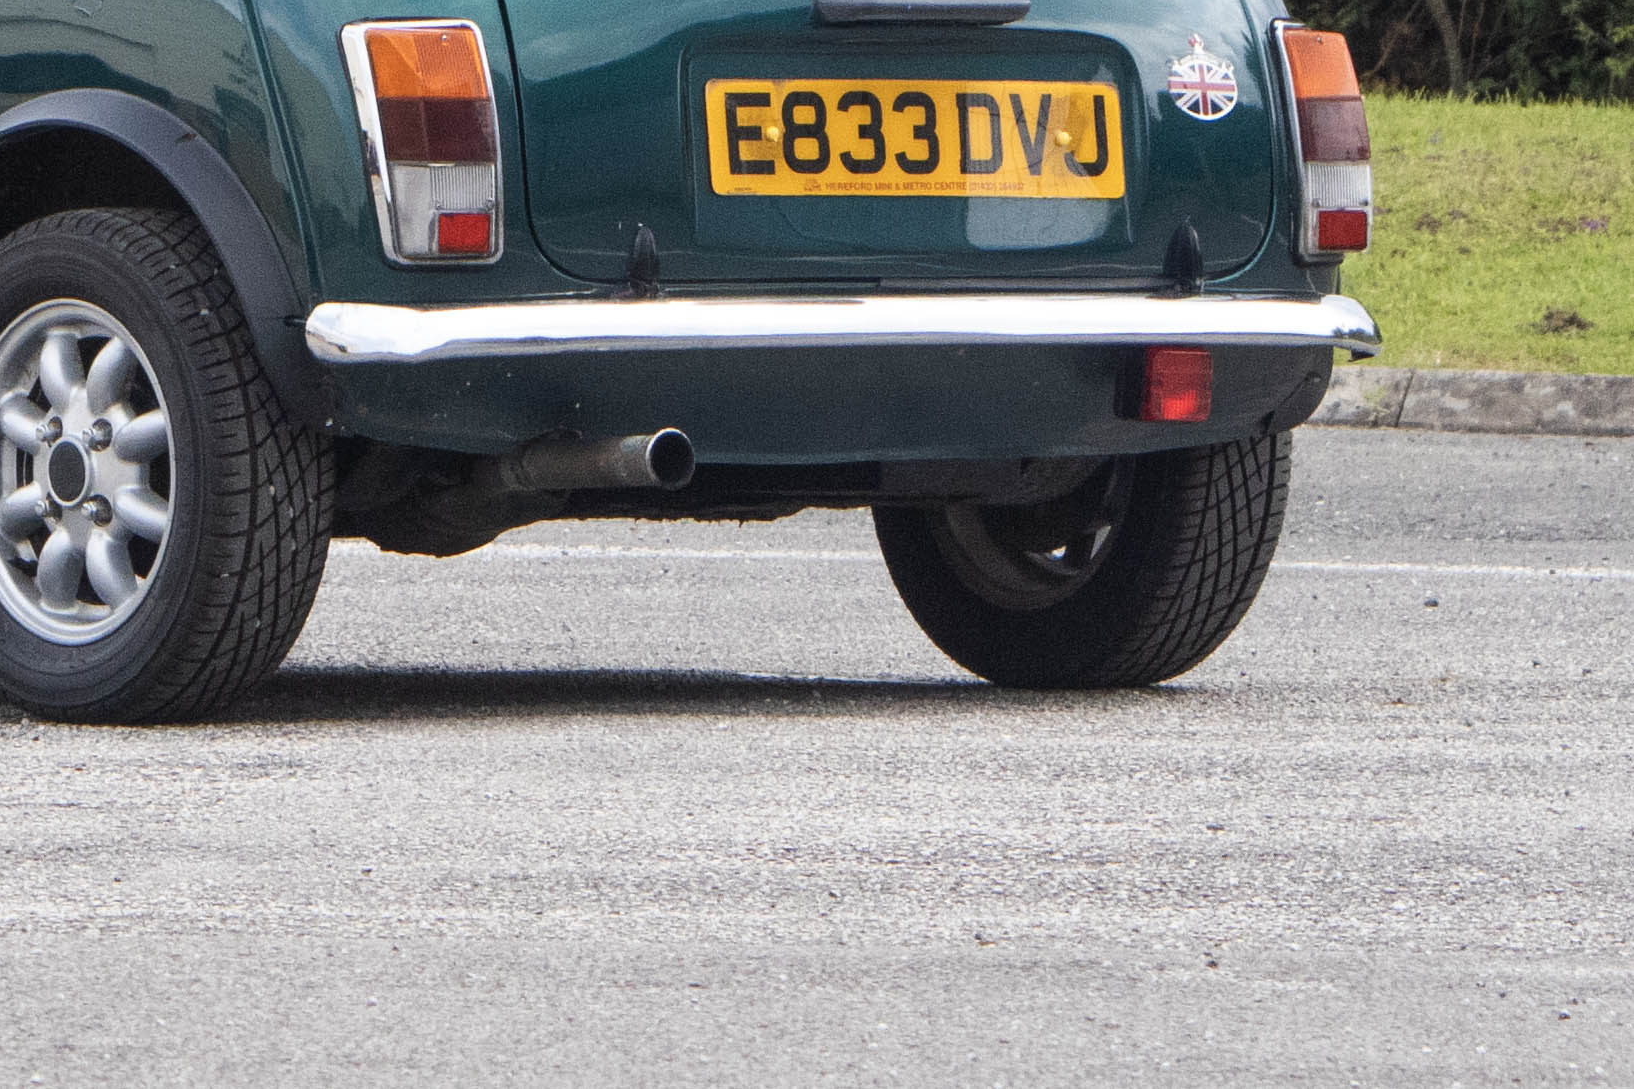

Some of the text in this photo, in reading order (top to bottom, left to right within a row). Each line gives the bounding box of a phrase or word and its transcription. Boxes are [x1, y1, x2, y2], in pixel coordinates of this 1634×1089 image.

[725, 91, 1108, 177] E833 DVJ
[825, 182, 872, 191] HEREFORD
[934, 182, 967, 191] CENTRE
